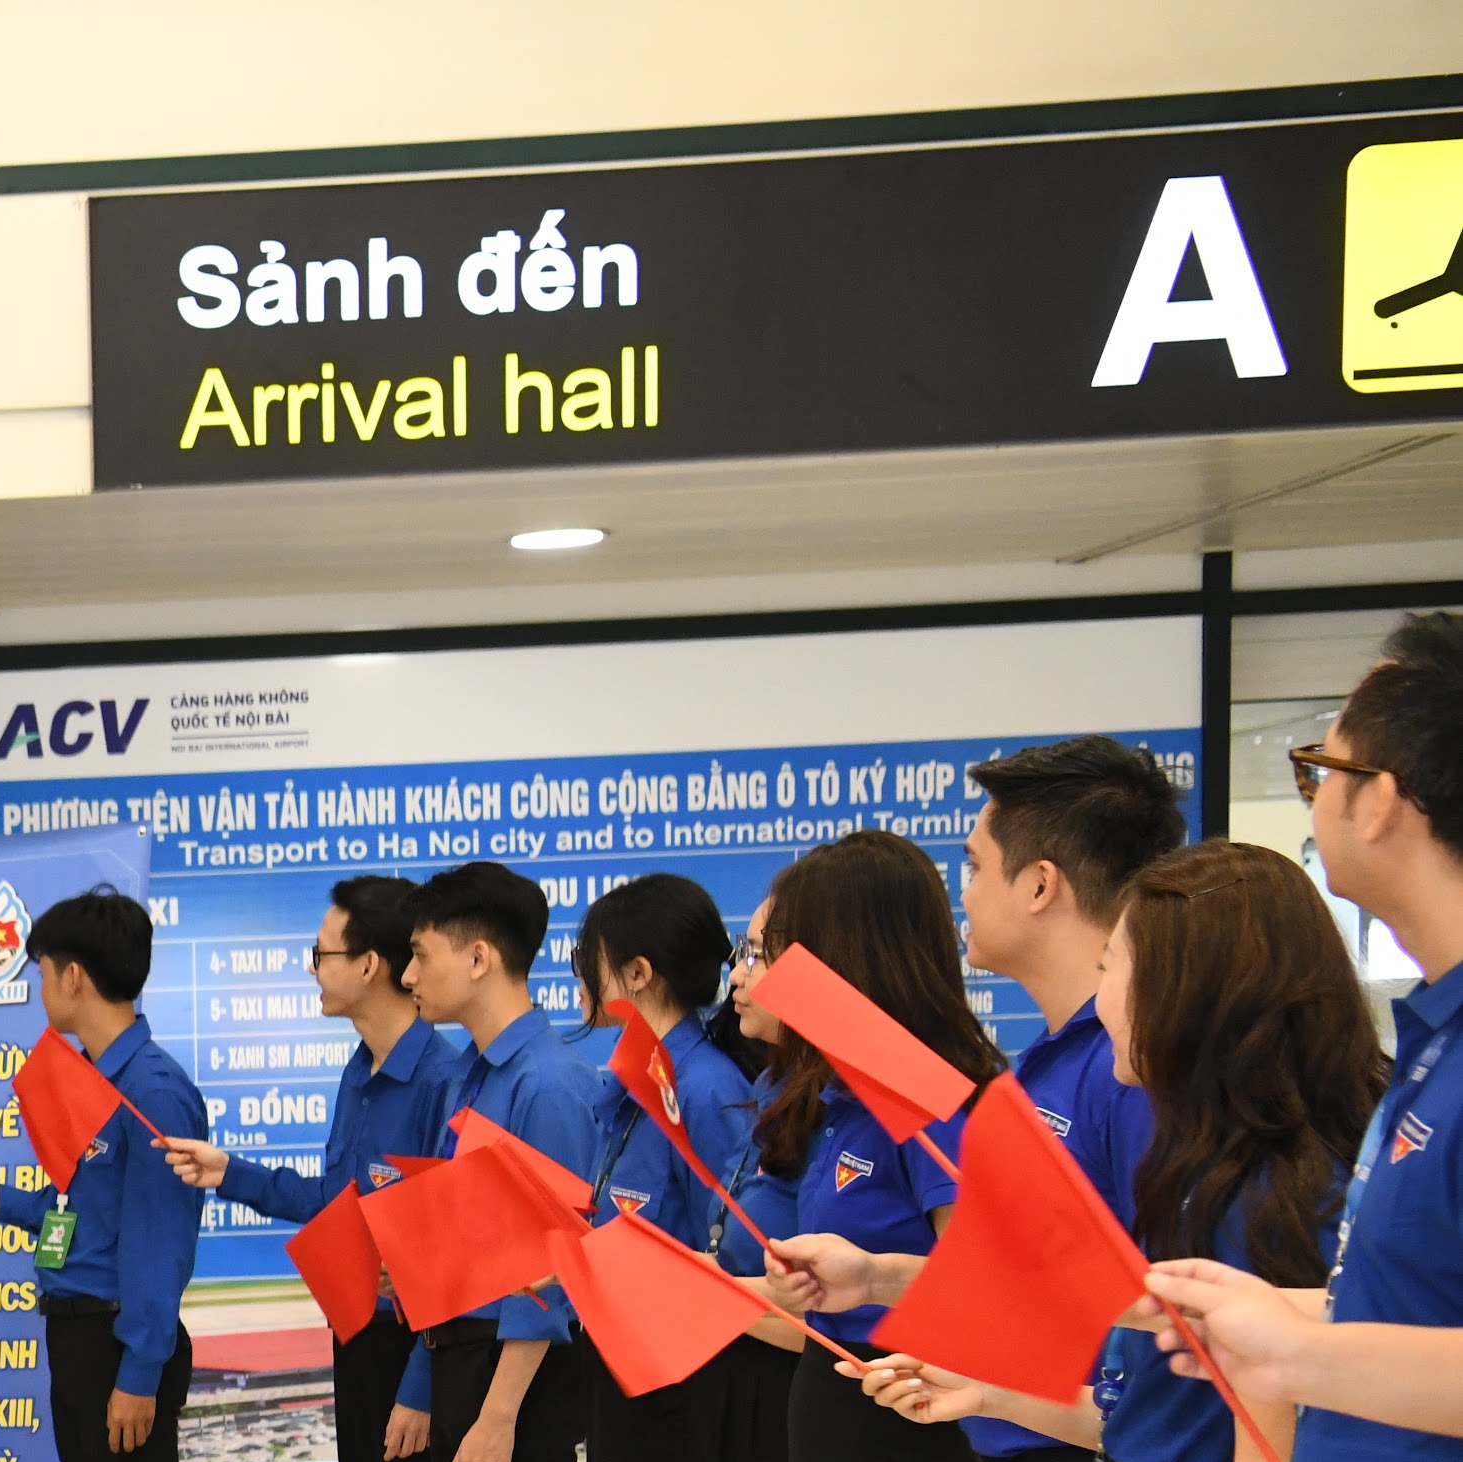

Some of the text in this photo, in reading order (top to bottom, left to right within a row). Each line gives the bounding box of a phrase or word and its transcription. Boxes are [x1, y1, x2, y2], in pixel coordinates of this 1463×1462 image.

[177, 210, 639, 331] Sảnh đến
[1090, 175, 1288, 387] A
[180, 344, 661, 450] Arrival hall
[214, 691, 254, 707] HÀNG
[259, 688, 309, 704] KHÔNG
[171, 710, 289, 731] QUỐC TẾ NỘI BÀI
[127, 788, 190, 842] TIỆN
[198, 786, 256, 840] VẬN
[264, 778, 308, 829] TẢI
[317, 781, 395, 827] HÀNH
[405, 776, 501, 824] KHÁCH
[511, 772, 589, 819] CÔNG
[598, 768, 678, 823] CỘNG
[687, 759, 767, 812] BẰNG
[777, 761, 796, 808] Ô
[804, 759, 840, 806] TÔ
[849, 757, 887, 805] KÝ
[896, 759, 955, 809] HỢP
[179, 837, 328, 869] Transport
[338, 835, 368, 860] to
[378, 832, 418, 858] Ha
[490, 827, 546, 859] city
[555, 823, 614, 851] and
[624, 824, 654, 848] to
[664, 812, 863, 846] International
[231, 949, 262, 974] TAXI
[266, 948, 288, 972] HP
[231, 995, 262, 1021] TAXI
[267, 994, 297, 1020] MAI
[228, 1045, 265, 1070] XANH
[269, 1044, 291, 1069] SM
[294, 1041, 350, 1068] AIRPORT
[225, 1131, 268, 1146] bus
